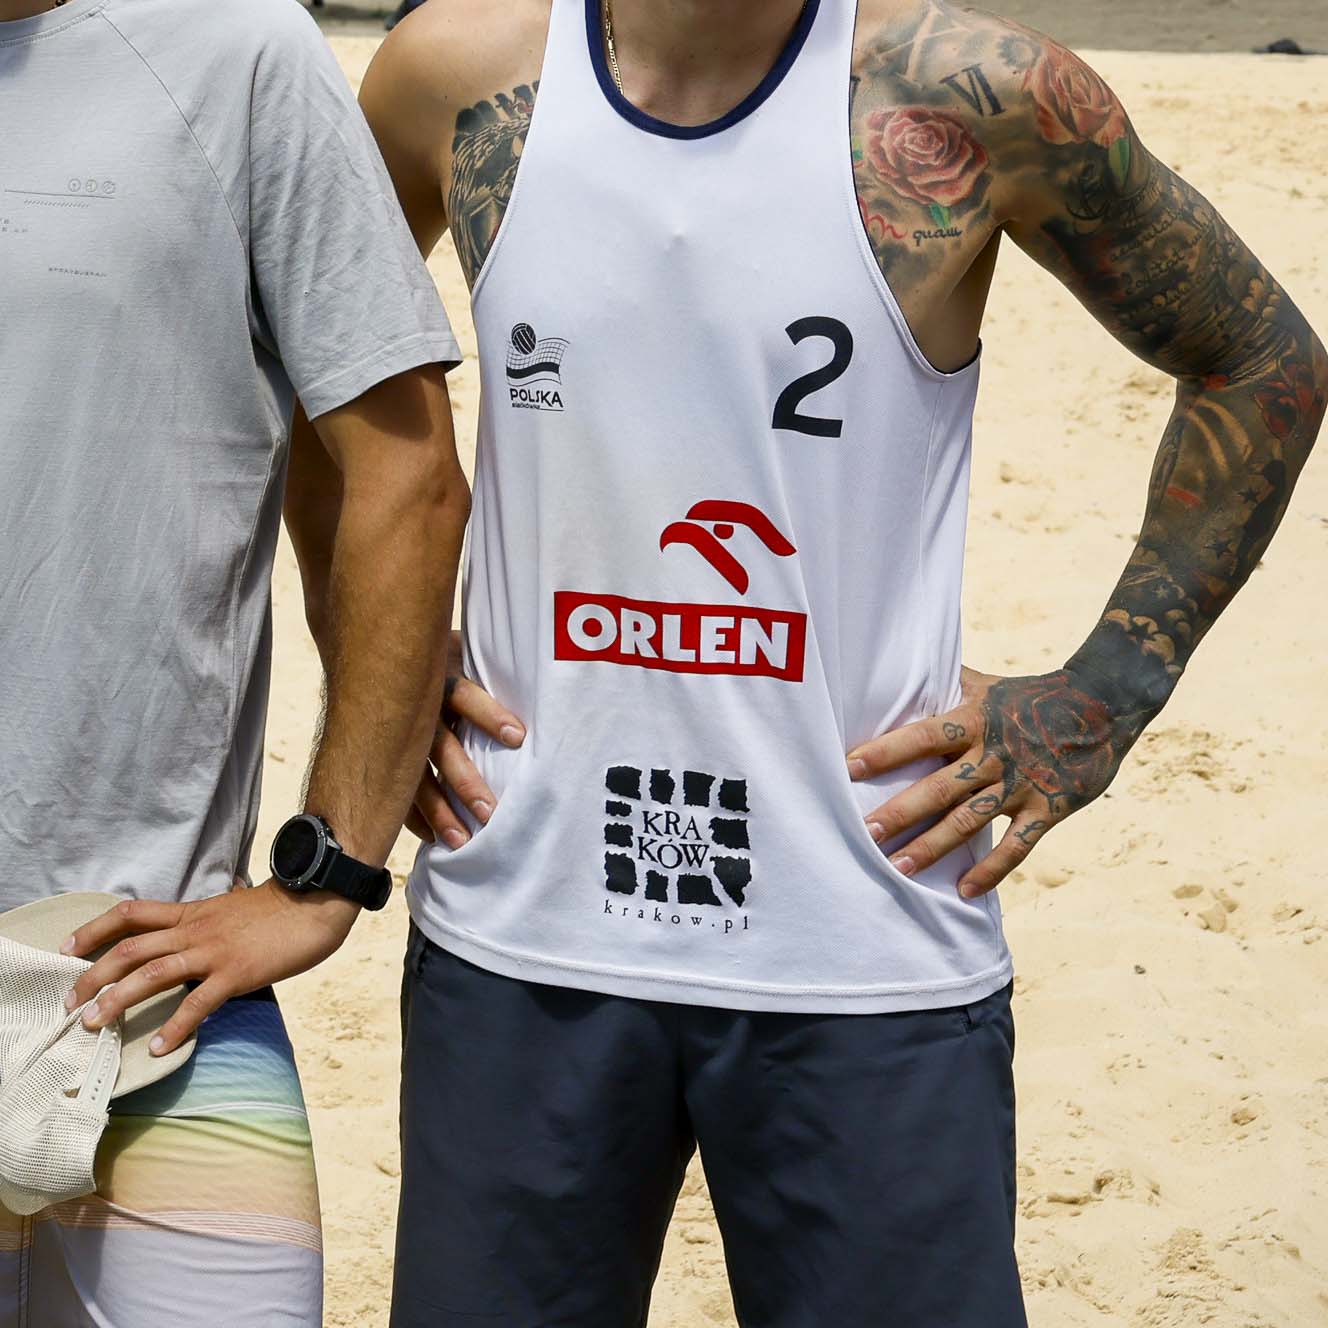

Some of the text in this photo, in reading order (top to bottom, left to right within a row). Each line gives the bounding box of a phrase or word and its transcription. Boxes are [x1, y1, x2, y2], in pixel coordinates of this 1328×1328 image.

[771, 315, 855, 439] 2
[509, 387, 564, 408] POLSKA
[565, 602, 790, 670] ORLEN
[641, 810, 703, 841] KRA
[637, 836, 710, 869] KÓW
[603, 898, 749, 934] krakow.pl
